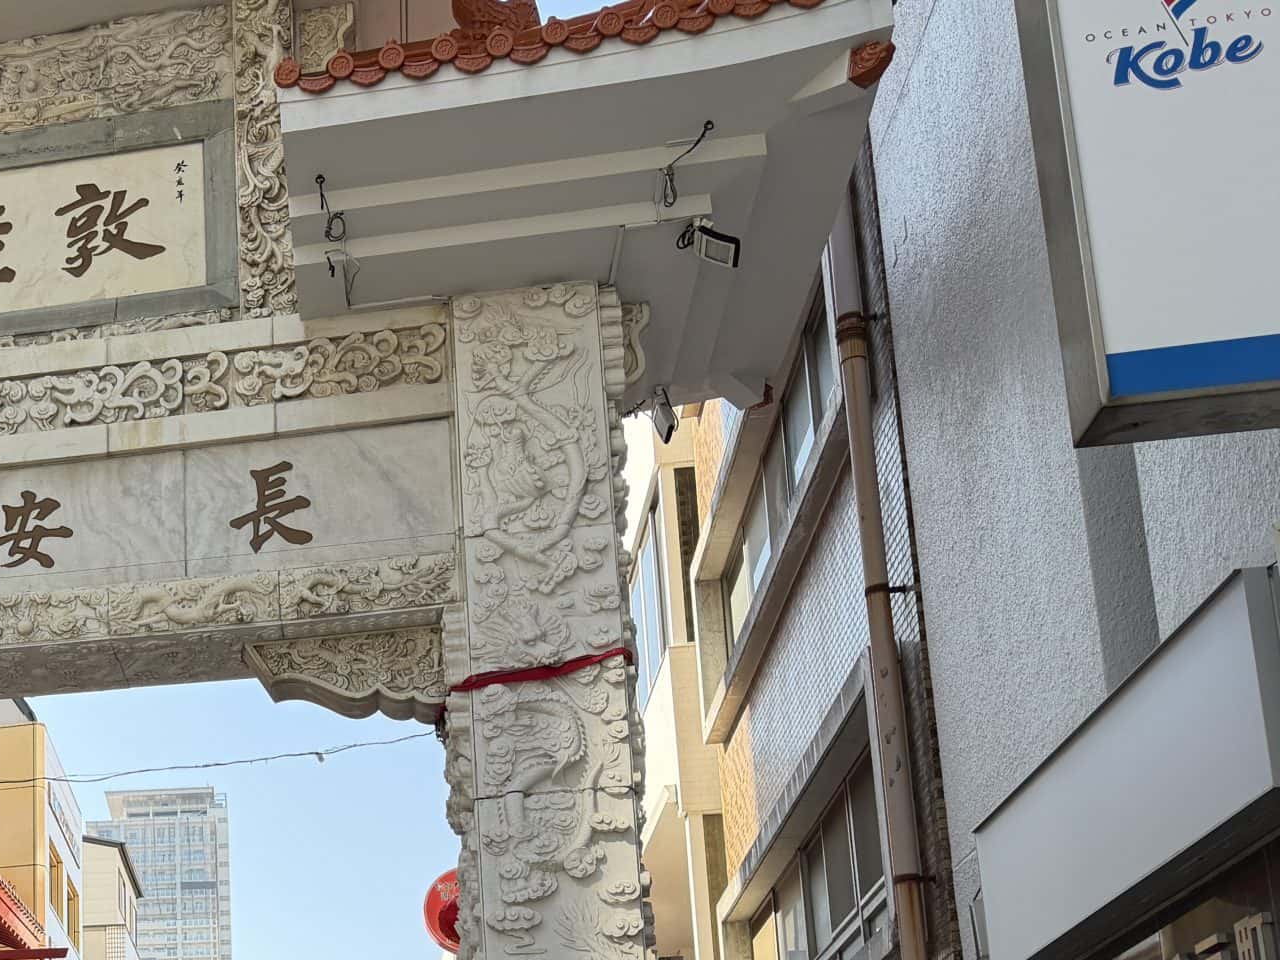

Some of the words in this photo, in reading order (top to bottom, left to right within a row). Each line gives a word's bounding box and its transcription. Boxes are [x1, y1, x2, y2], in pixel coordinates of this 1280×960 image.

[1085, 22, 1167, 43] OCEAN
[1189, 7, 1272, 28] TOKYO
[1107, 26, 1264, 90] Kobe
